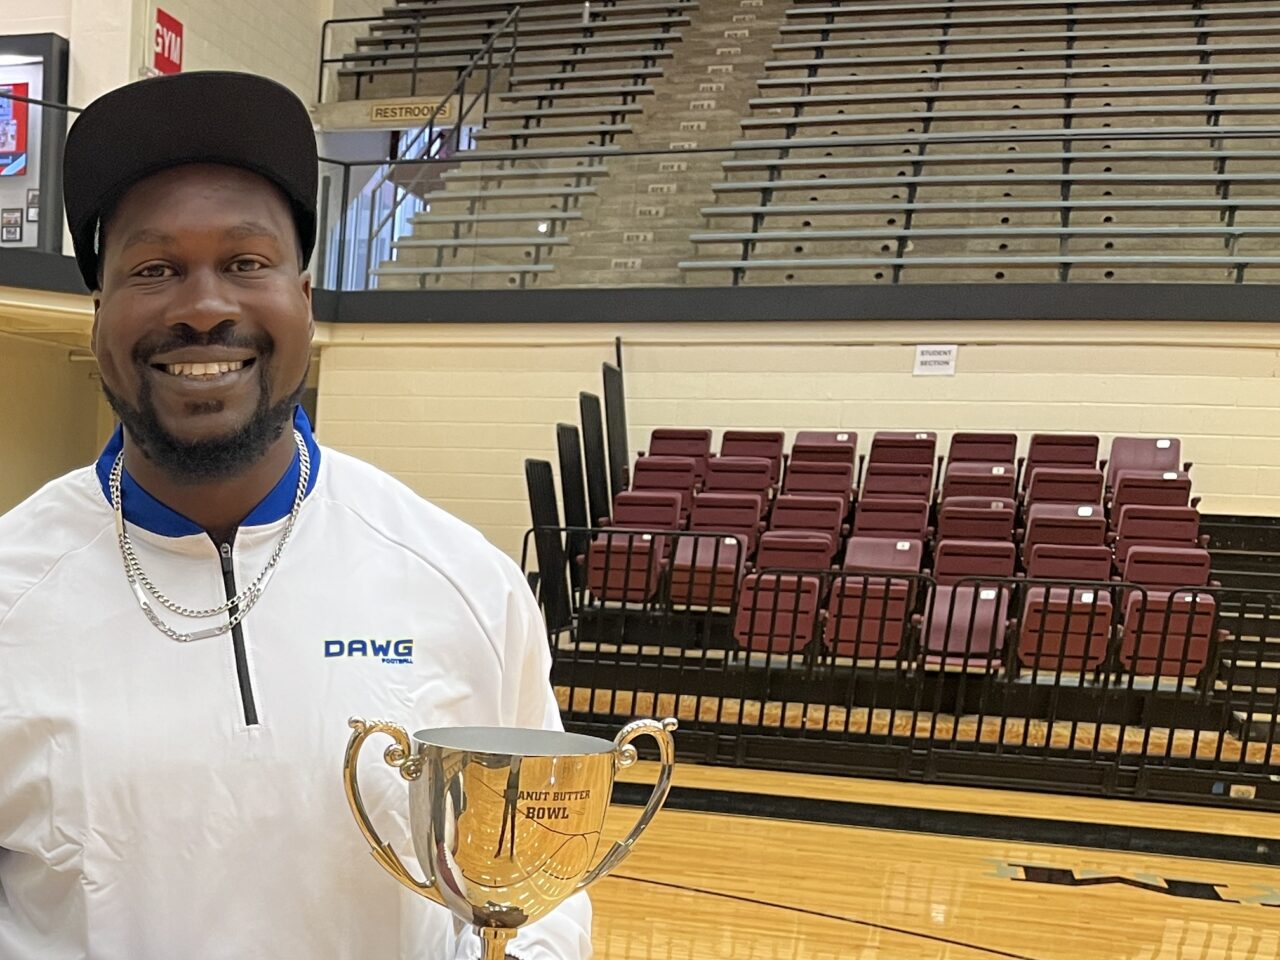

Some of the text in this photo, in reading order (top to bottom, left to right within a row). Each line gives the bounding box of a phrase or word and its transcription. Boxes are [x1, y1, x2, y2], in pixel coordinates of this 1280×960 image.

[154, 22, 180, 65] GYM
[374, 105, 447, 118] RESTROOMS
[324, 639, 414, 657] DAWG
[552, 789, 590, 801] BUTTER
[525, 807, 569, 819] BOWL
